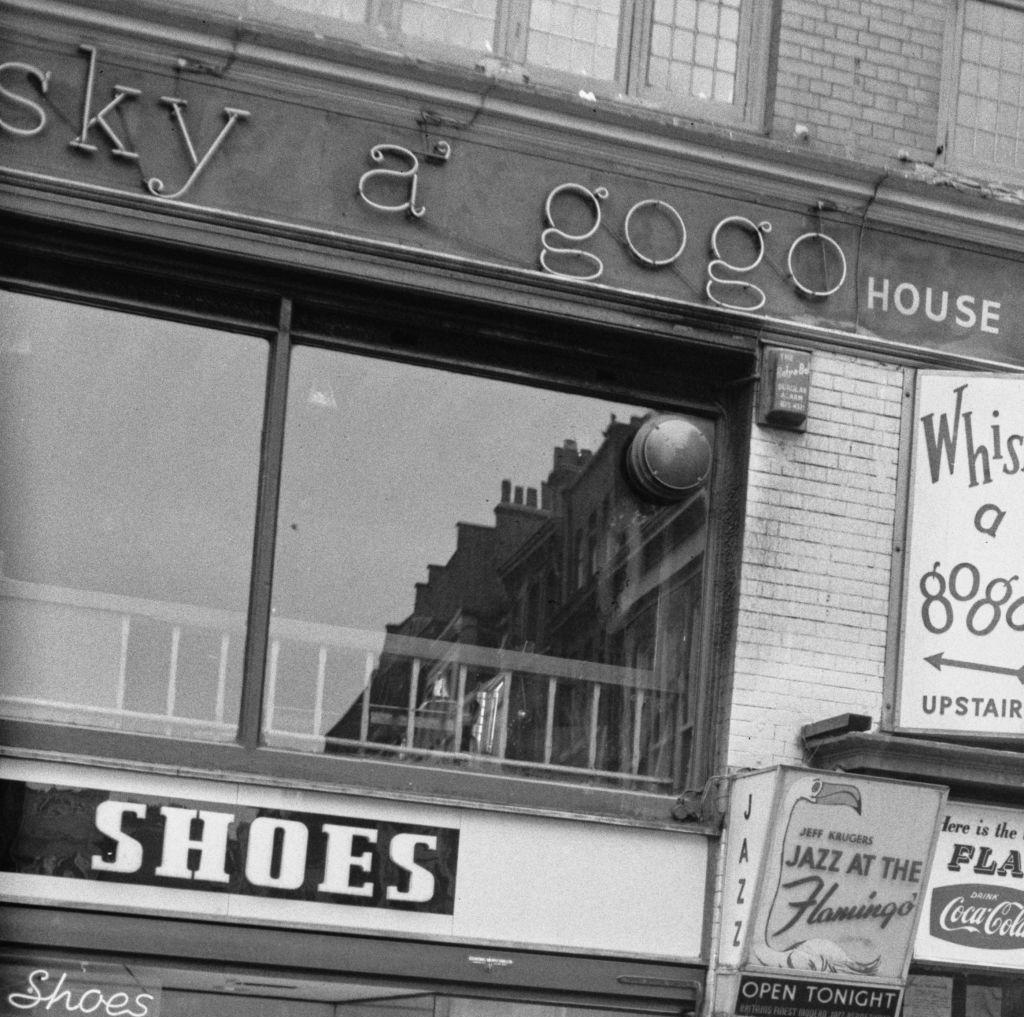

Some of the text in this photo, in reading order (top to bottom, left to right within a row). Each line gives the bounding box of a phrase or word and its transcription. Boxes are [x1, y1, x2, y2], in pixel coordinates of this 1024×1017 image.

[867, 276, 1001, 335] HOUSE
[973, 503, 1006, 538] a
[800, 827, 874, 846] JEFF KRUGERS
[976, 818, 990, 836] is
[994, 820, 1018, 841] the
[91, 798, 438, 904] SHOES
[785, 845, 923, 884] JAZZ AT THE
[732, 793, 753, 947] JAZZ
[970, 891, 1000, 901] DRINK
[741, 981, 897, 1009] OPEN TONIGHT
